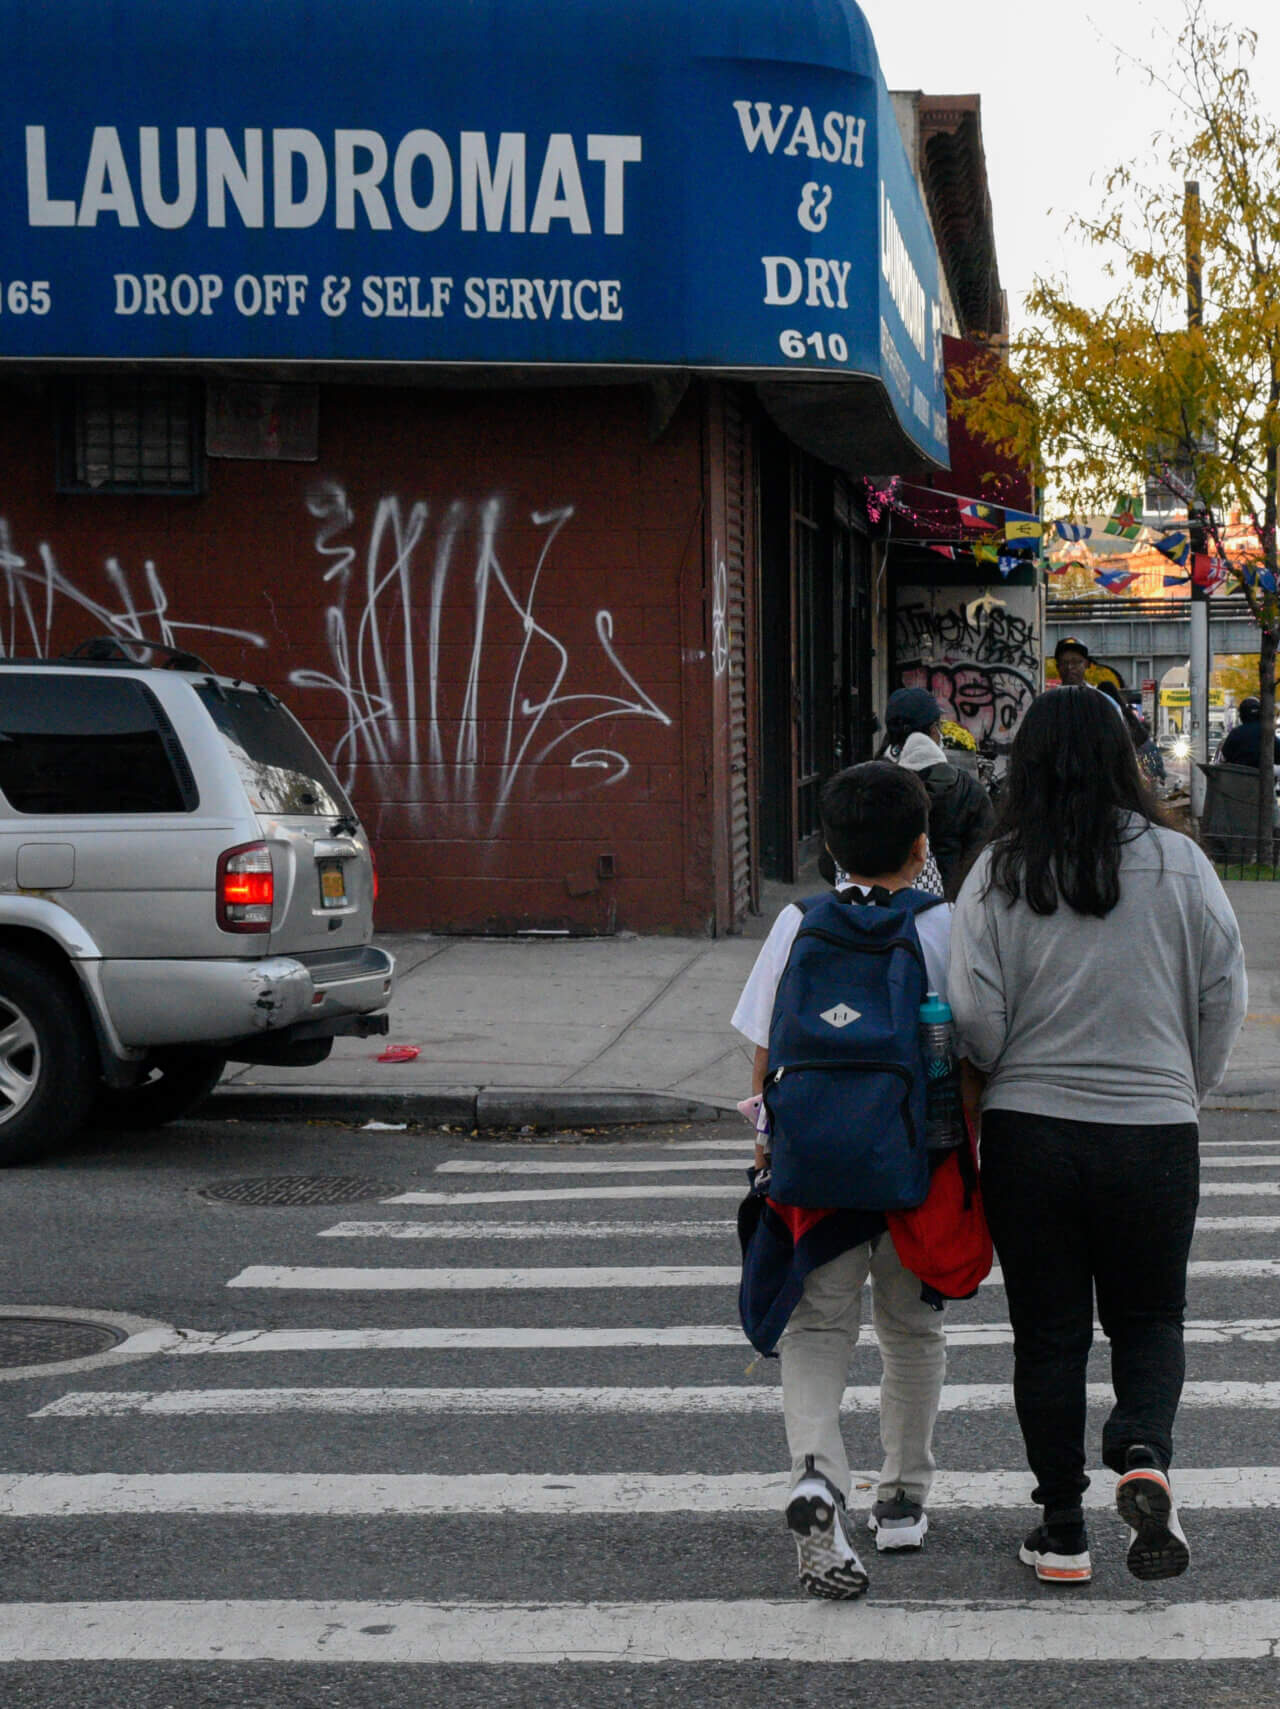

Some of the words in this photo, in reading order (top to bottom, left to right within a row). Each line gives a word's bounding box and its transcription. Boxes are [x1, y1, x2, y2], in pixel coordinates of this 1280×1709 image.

[733, 100, 866, 168] WASH
[25, 125, 642, 235] LAUNDROMAT
[797, 181, 832, 232] &
[0, 281, 50, 315] 65
[113, 274, 223, 316] DROP
[234, 274, 309, 316] OFF
[321, 275, 350, 317] &
[361, 275, 453, 317] SELF
[464, 277, 623, 321] SERVICE
[761, 256, 851, 309] DRY
[779, 329, 849, 362] 610
